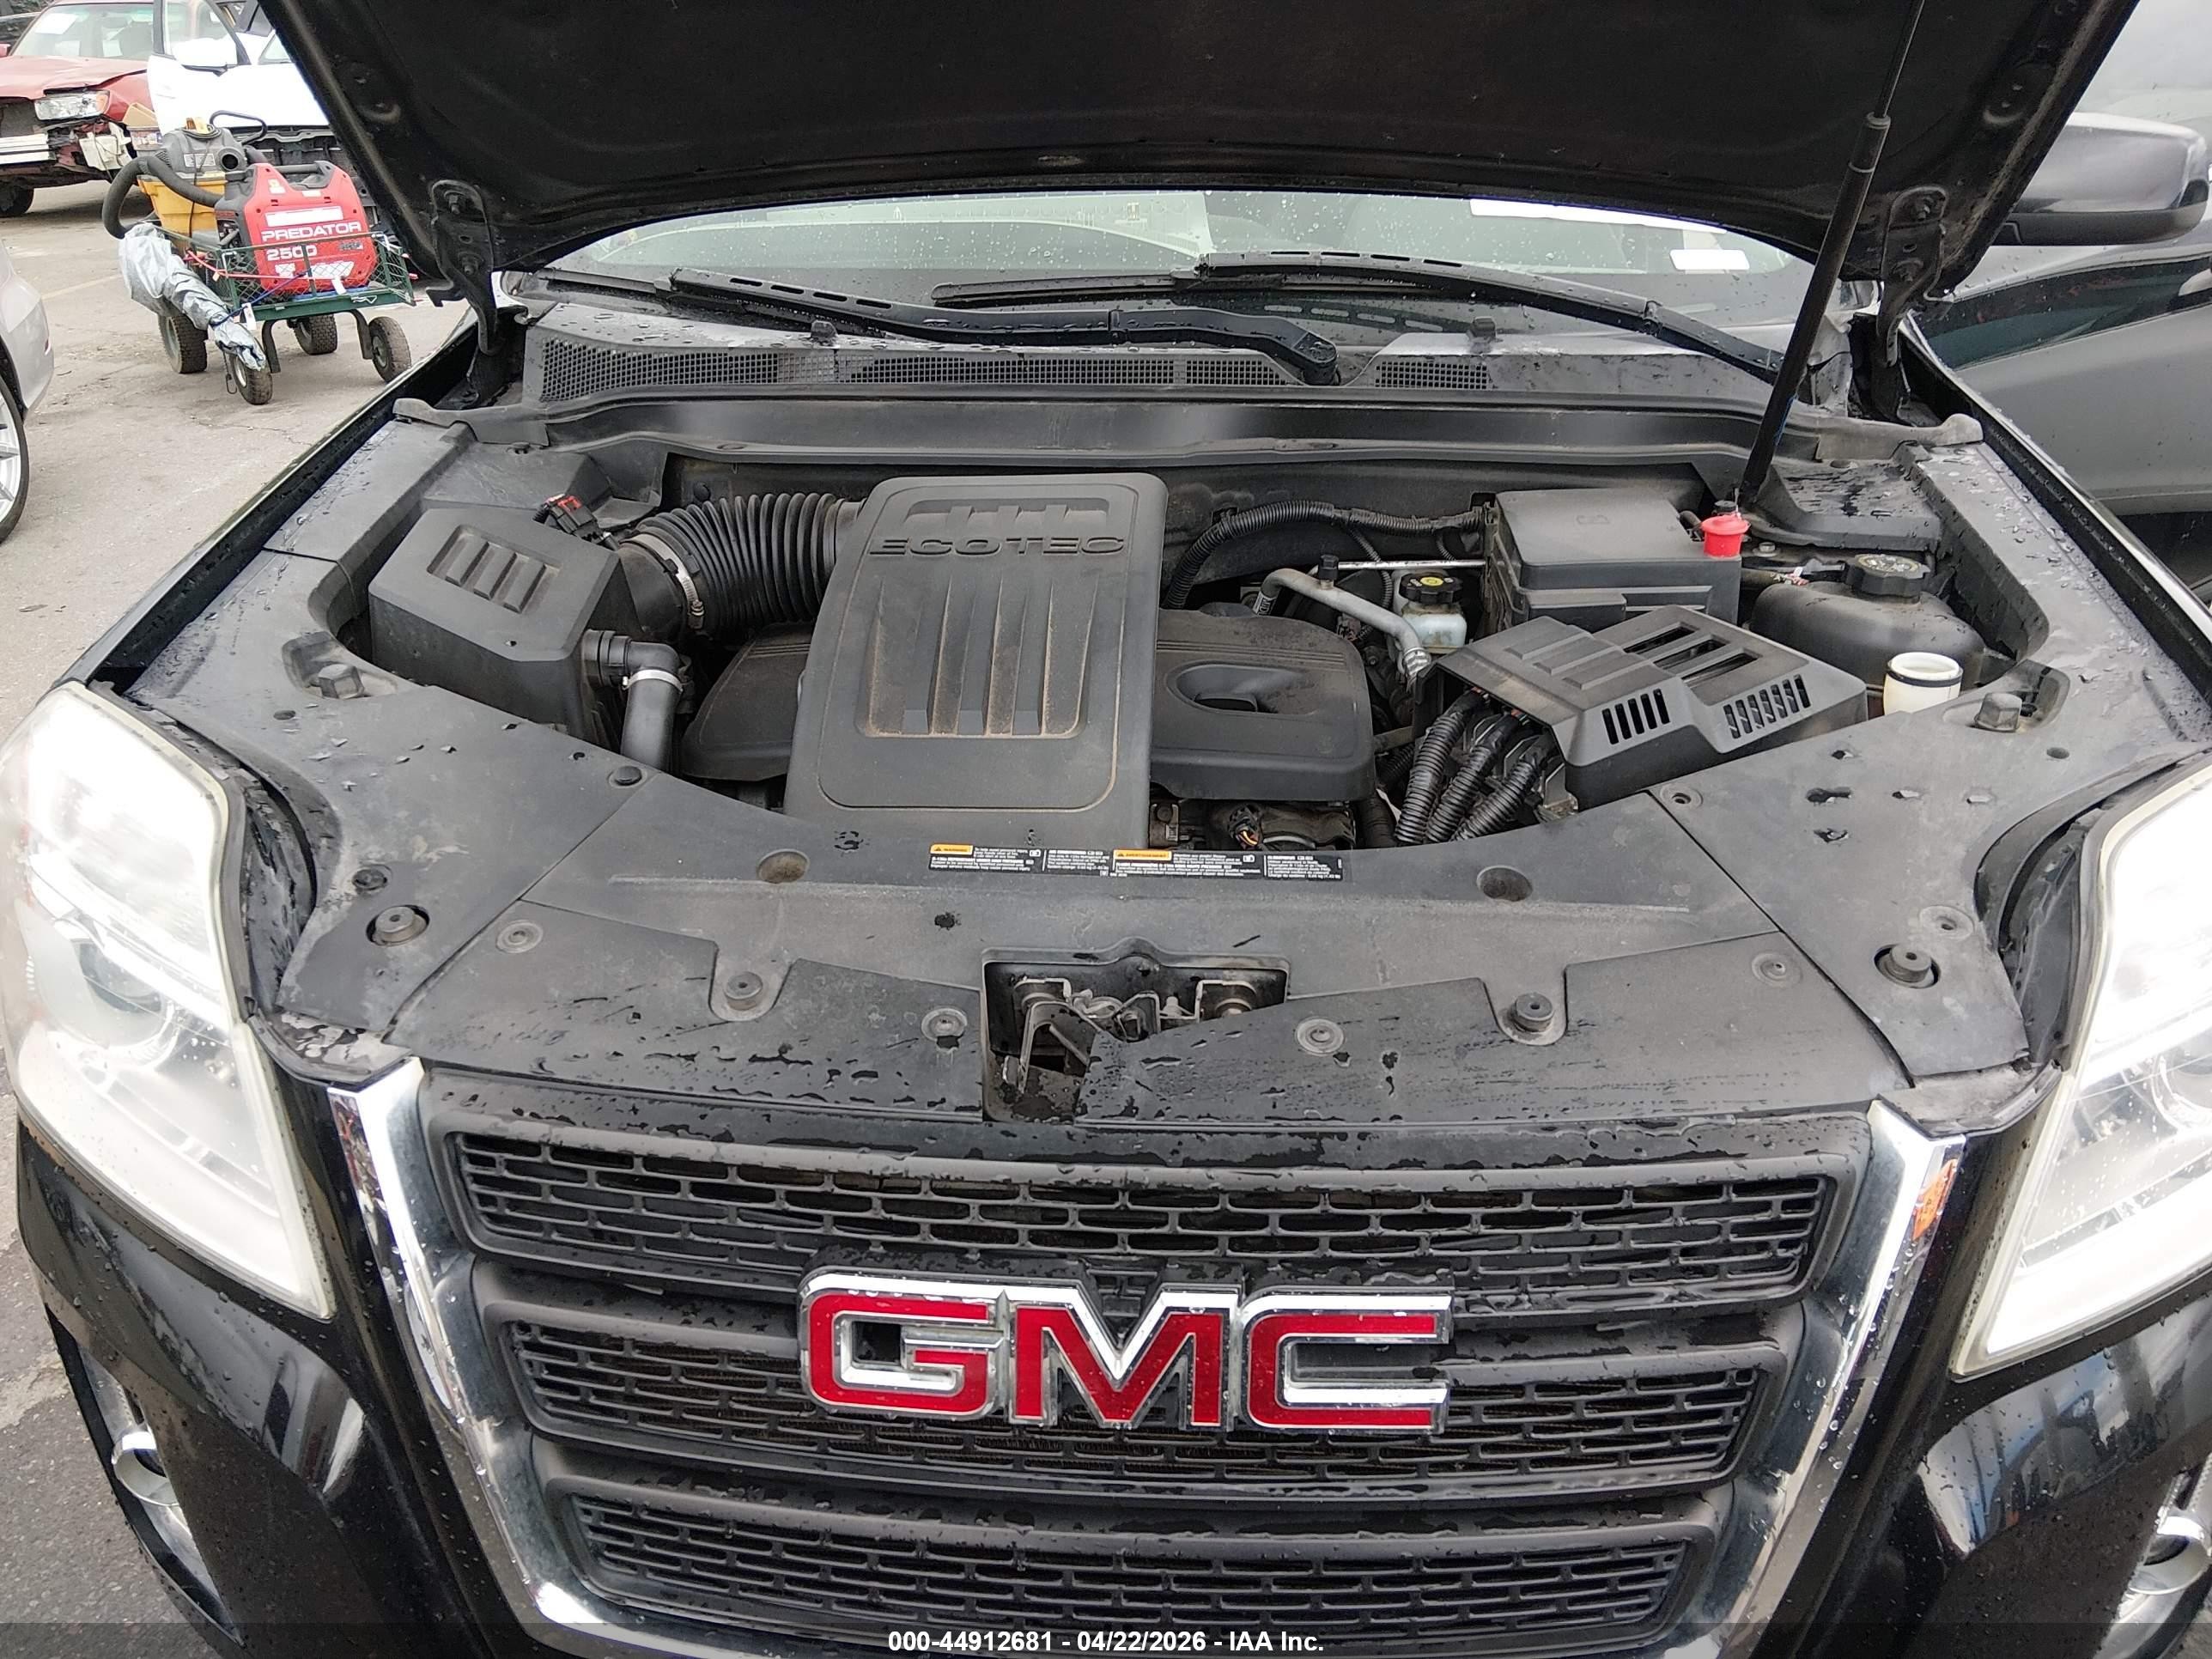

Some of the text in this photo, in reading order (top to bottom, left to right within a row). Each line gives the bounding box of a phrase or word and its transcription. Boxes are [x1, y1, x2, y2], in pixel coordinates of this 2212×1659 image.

[261, 222, 362, 242] PREDATOR
[266, 245, 318, 261] 2500
[869, 537, 1125, 556] ECOTEC
[799, 1269, 1453, 1432] GMC
